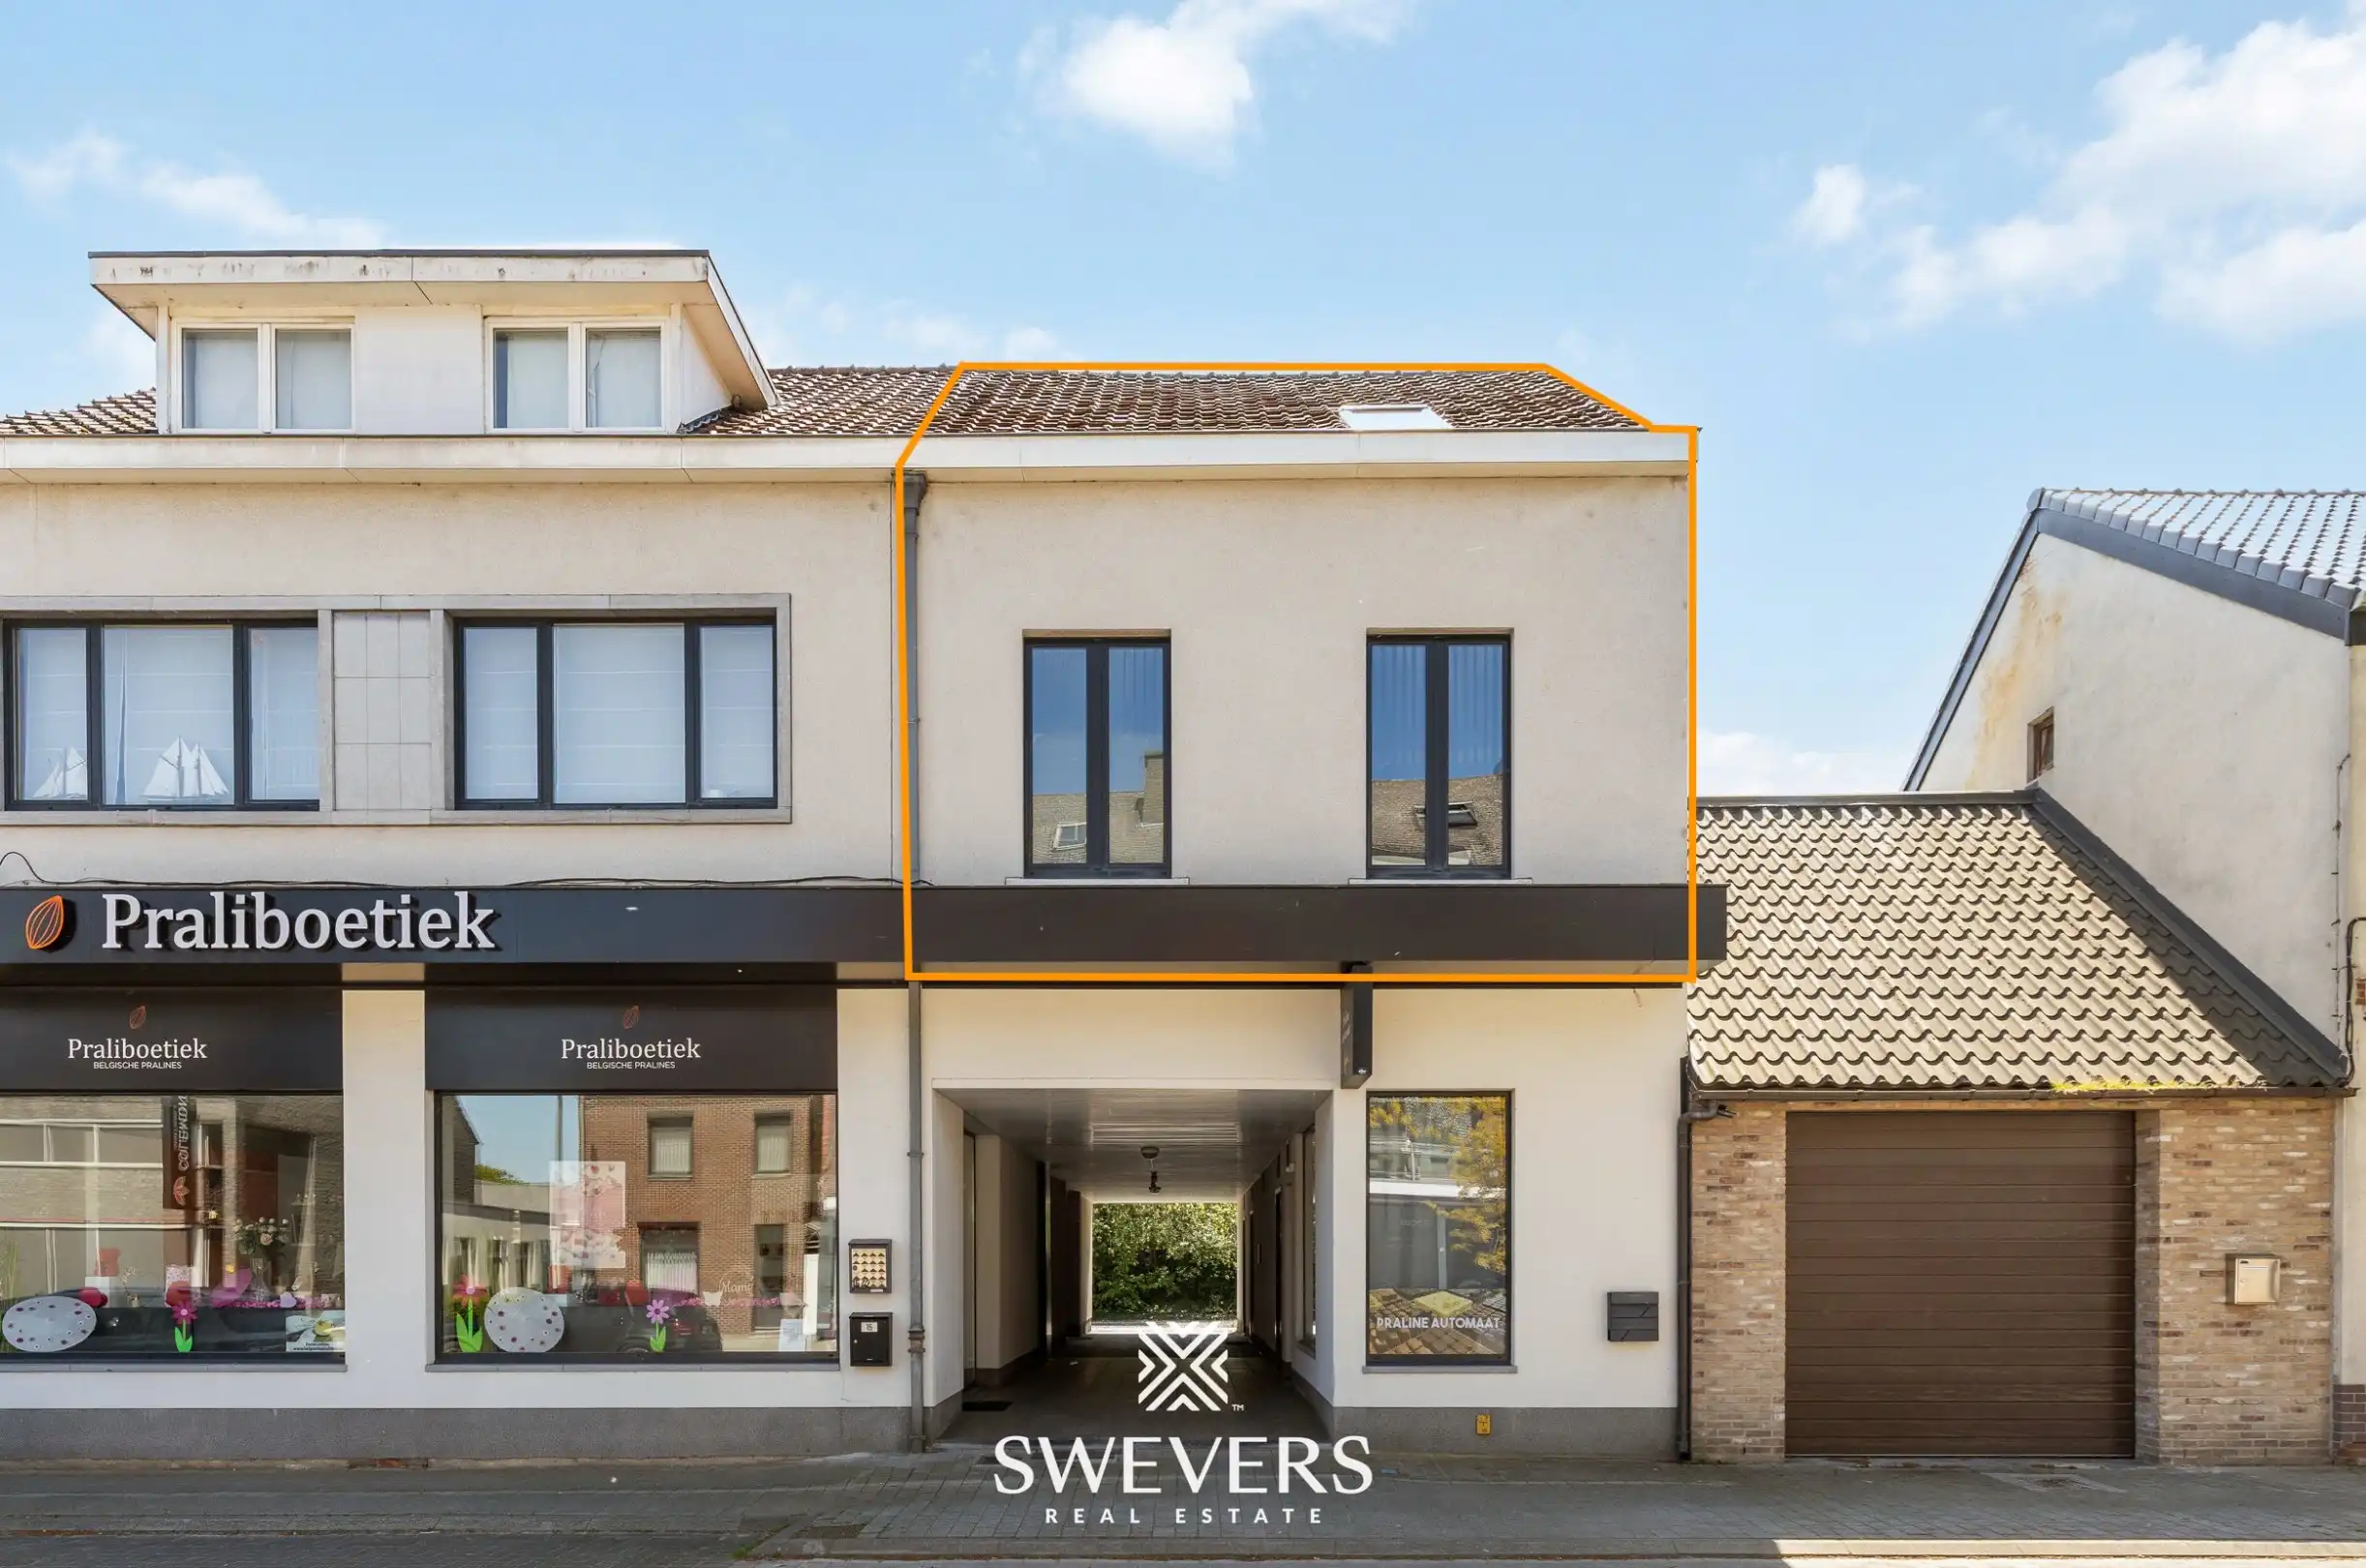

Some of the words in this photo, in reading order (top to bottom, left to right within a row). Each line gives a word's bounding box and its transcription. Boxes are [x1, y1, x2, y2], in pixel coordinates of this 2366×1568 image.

[102, 890, 496, 950] Praliboetiek
[67, 1038, 208, 1059] Praliboetiek
[561, 1038, 702, 1059] Praliboetiek
[93, 1061, 139, 1070] BELGISCHE
[140, 1061, 182, 1070] PRALINES
[587, 1061, 633, 1070] BELGISCHE
[634, 1061, 676, 1070] PRALINES
[1377, 1316, 1429, 1329] PRALINE
[1431, 1316, 1501, 1329] AUTOMAAT
